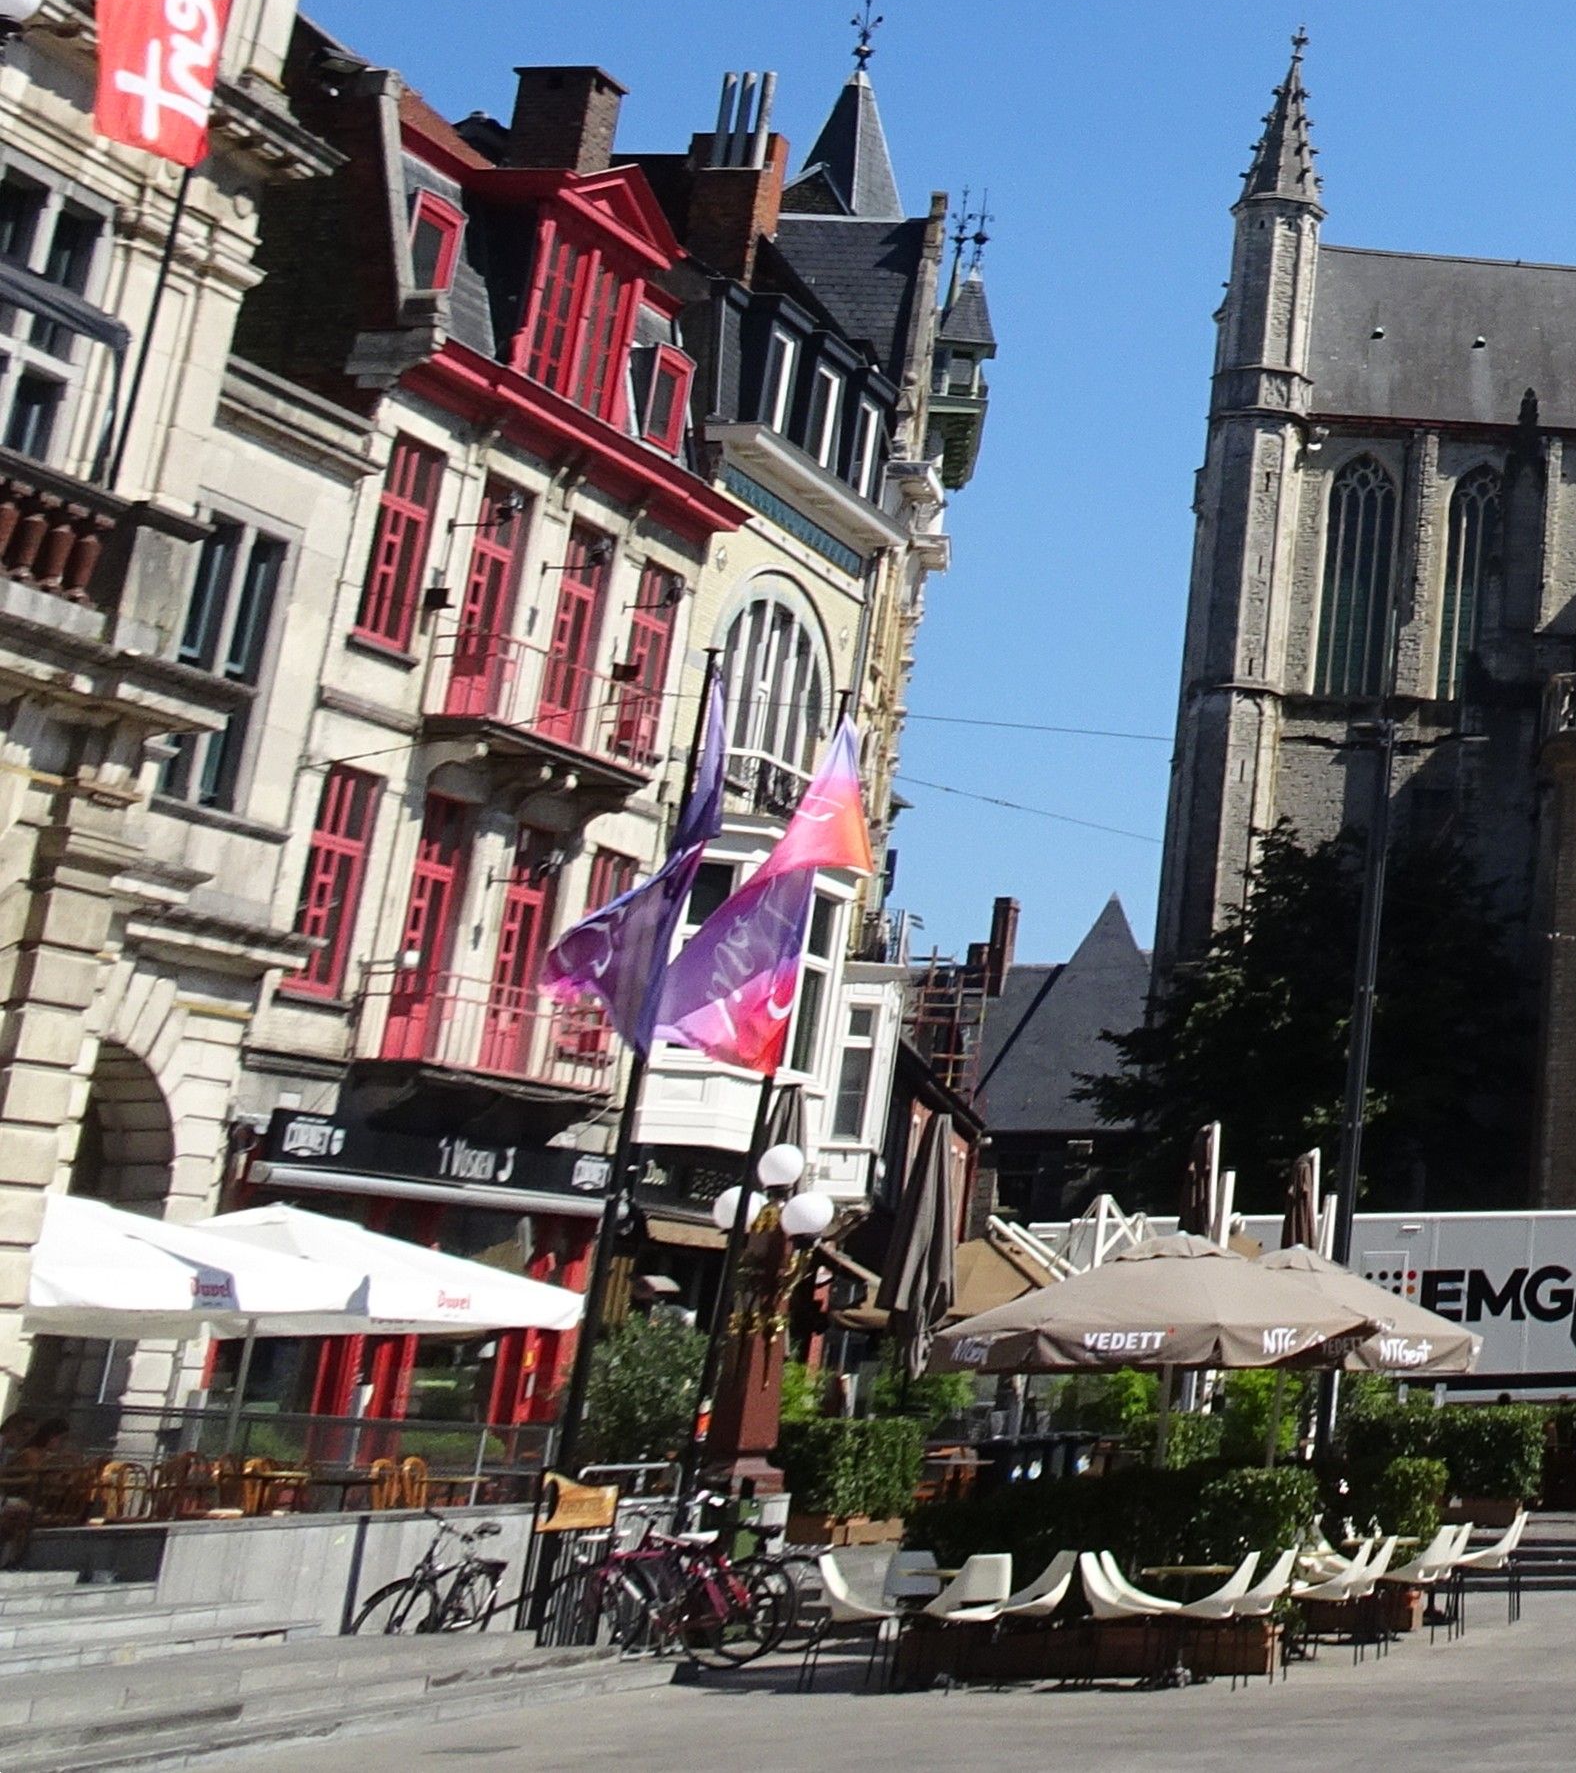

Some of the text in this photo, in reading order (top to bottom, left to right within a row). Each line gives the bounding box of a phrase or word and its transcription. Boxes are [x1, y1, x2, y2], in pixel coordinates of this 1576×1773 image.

[1420, 1265, 1574, 1322] EMG
[1084, 1331, 1166, 1351] VEDETT
[1380, 1339, 1432, 1365] NTGent
